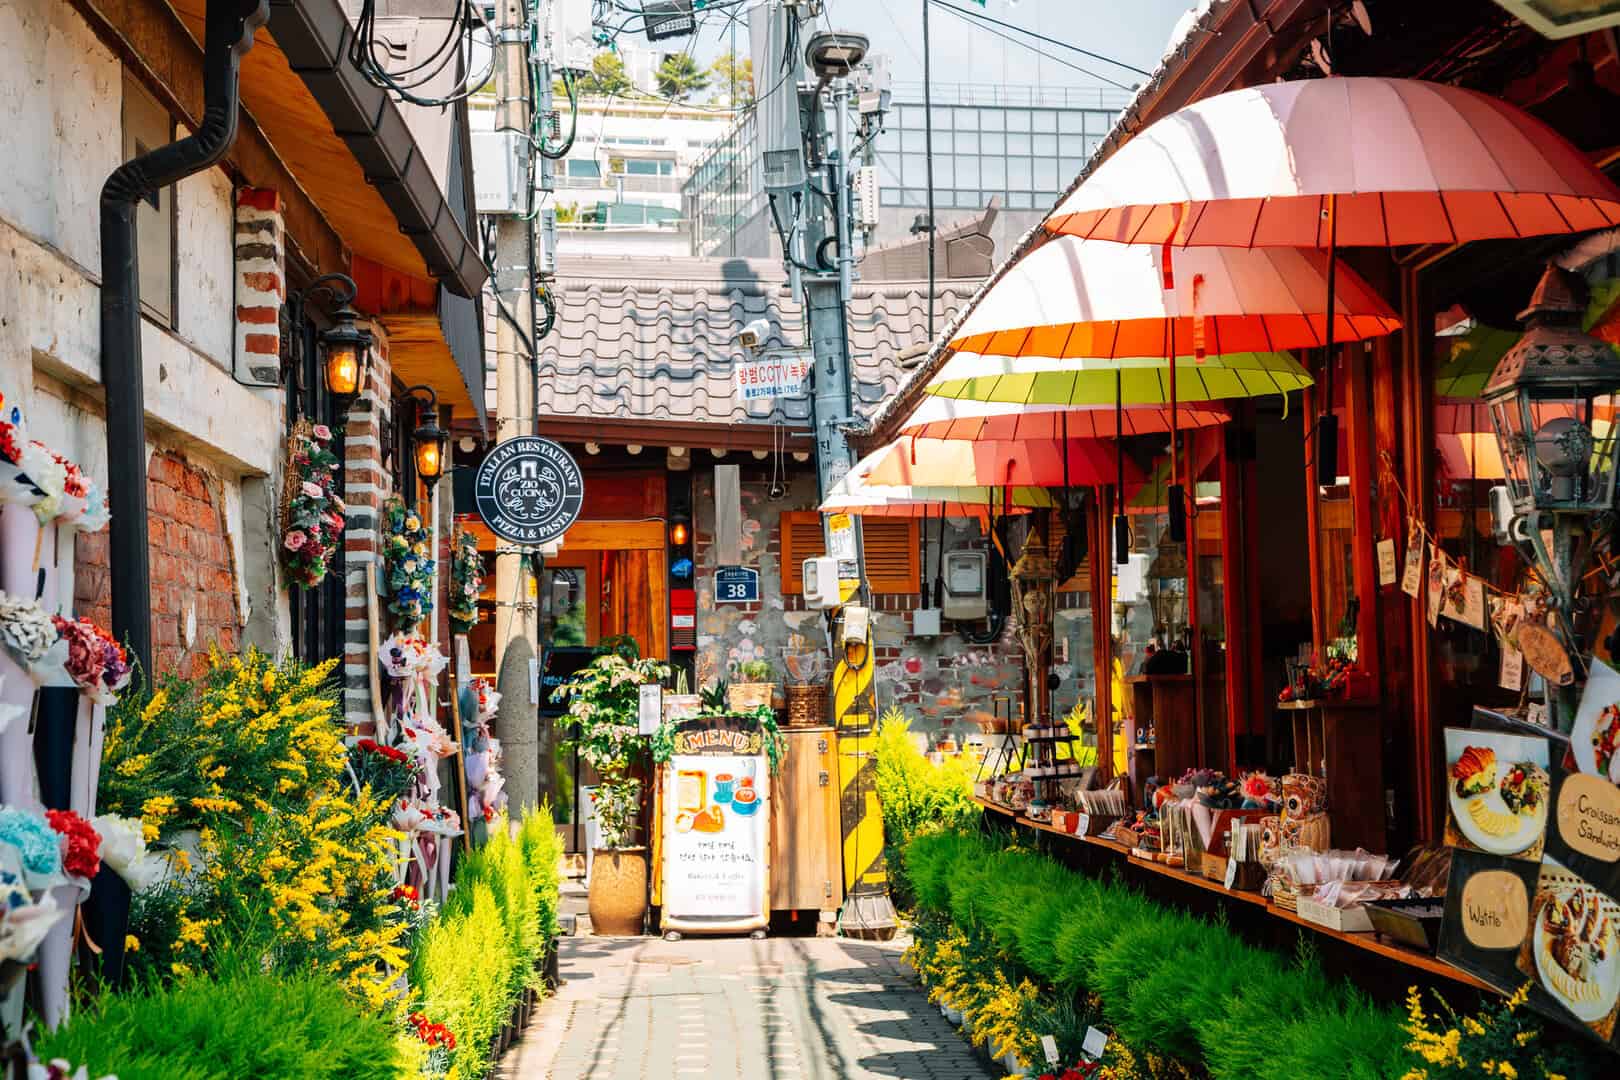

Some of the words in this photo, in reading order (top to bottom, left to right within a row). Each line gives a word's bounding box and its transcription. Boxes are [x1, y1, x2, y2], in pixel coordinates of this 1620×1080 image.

[479, 445, 516, 487] ITALIAN
[517, 441, 579, 488] RESTAURANT
[520, 480, 538, 488] ZIO
[511, 489, 548, 497] CUCINA
[492, 515, 525, 538] PIZZA
[527, 529, 537, 538] &
[538, 511, 572, 537] PASTA
[727, 584, 746, 598] 38
[687, 729, 747, 750] MENU
